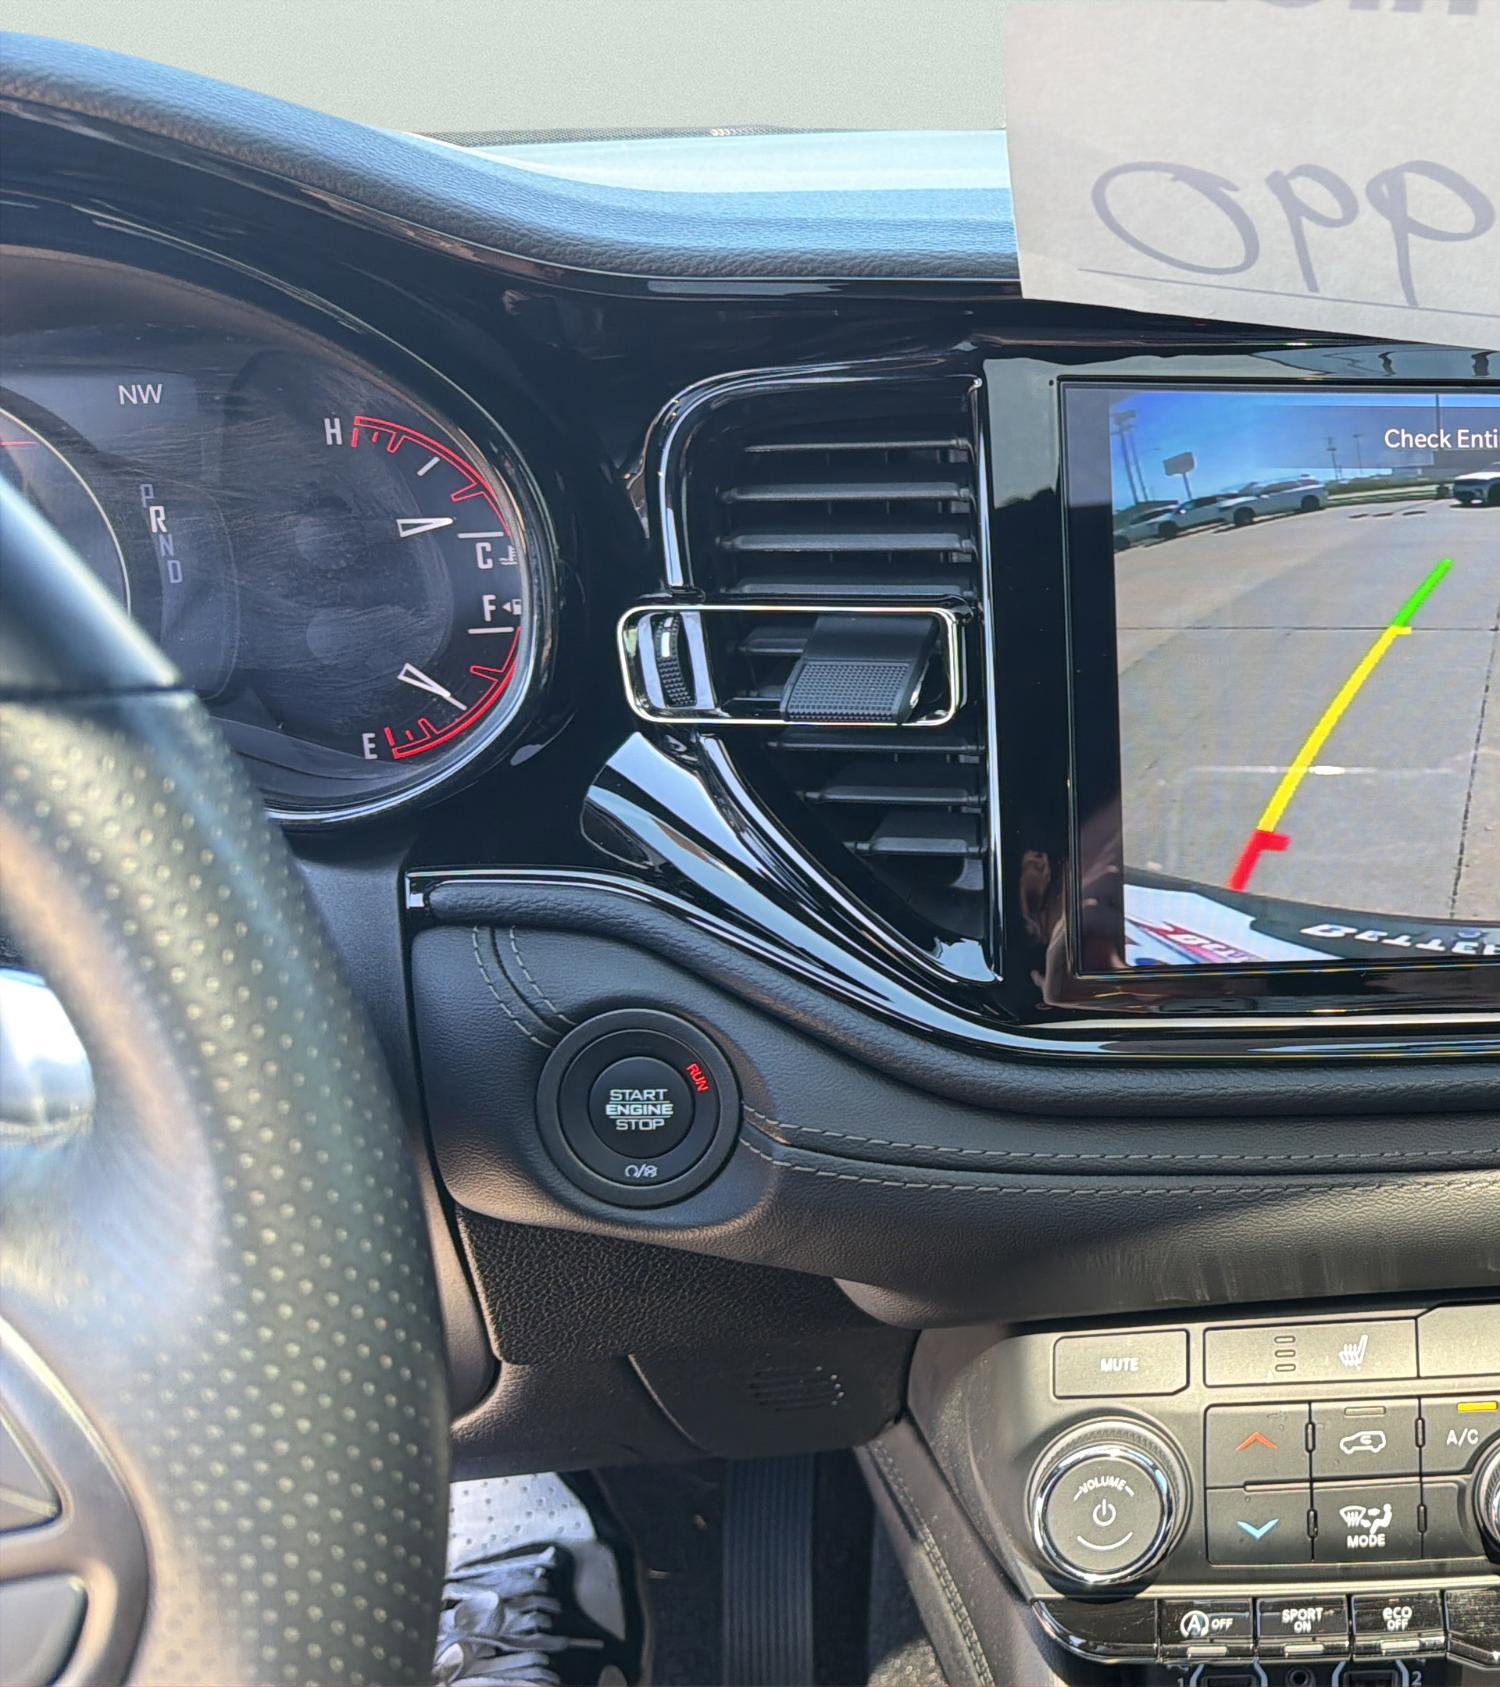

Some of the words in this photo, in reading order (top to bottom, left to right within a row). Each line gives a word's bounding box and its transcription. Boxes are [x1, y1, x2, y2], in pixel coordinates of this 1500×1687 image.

[118, 384, 163, 406] NW
[324, 418, 343, 446] H
[1384, 428, 1452, 449] Check
[140, 483, 154, 508] P
[149, 505, 167, 533] R
[160, 534, 174, 558] N
[475, 542, 493, 569] C
[167, 559, 182, 584] D
[482, 594, 496, 622] F
[362, 732, 378, 760] E
[686, 1063, 710, 1093] RUN
[610, 1088, 668, 1101] START
[605, 1104, 674, 1115] ENGINE
[616, 1119, 665, 1131] STOP
[1100, 1356, 1139, 1373] MUTE
[1447, 1428, 1479, 1447] A/C
[1079, 1475, 1127, 1493] VOLUME
[1346, 1533, 1386, 1549] MODE
[1282, 1607, 1323, 1623] SPORT
[1382, 1606, 1412, 1620] eco
[1211, 1618, 1233, 1630] OFF
[1294, 1621, 1312, 1633] ON
[1387, 1619, 1409, 1632] OFF
[1412, 1671, 1422, 1686] 2
